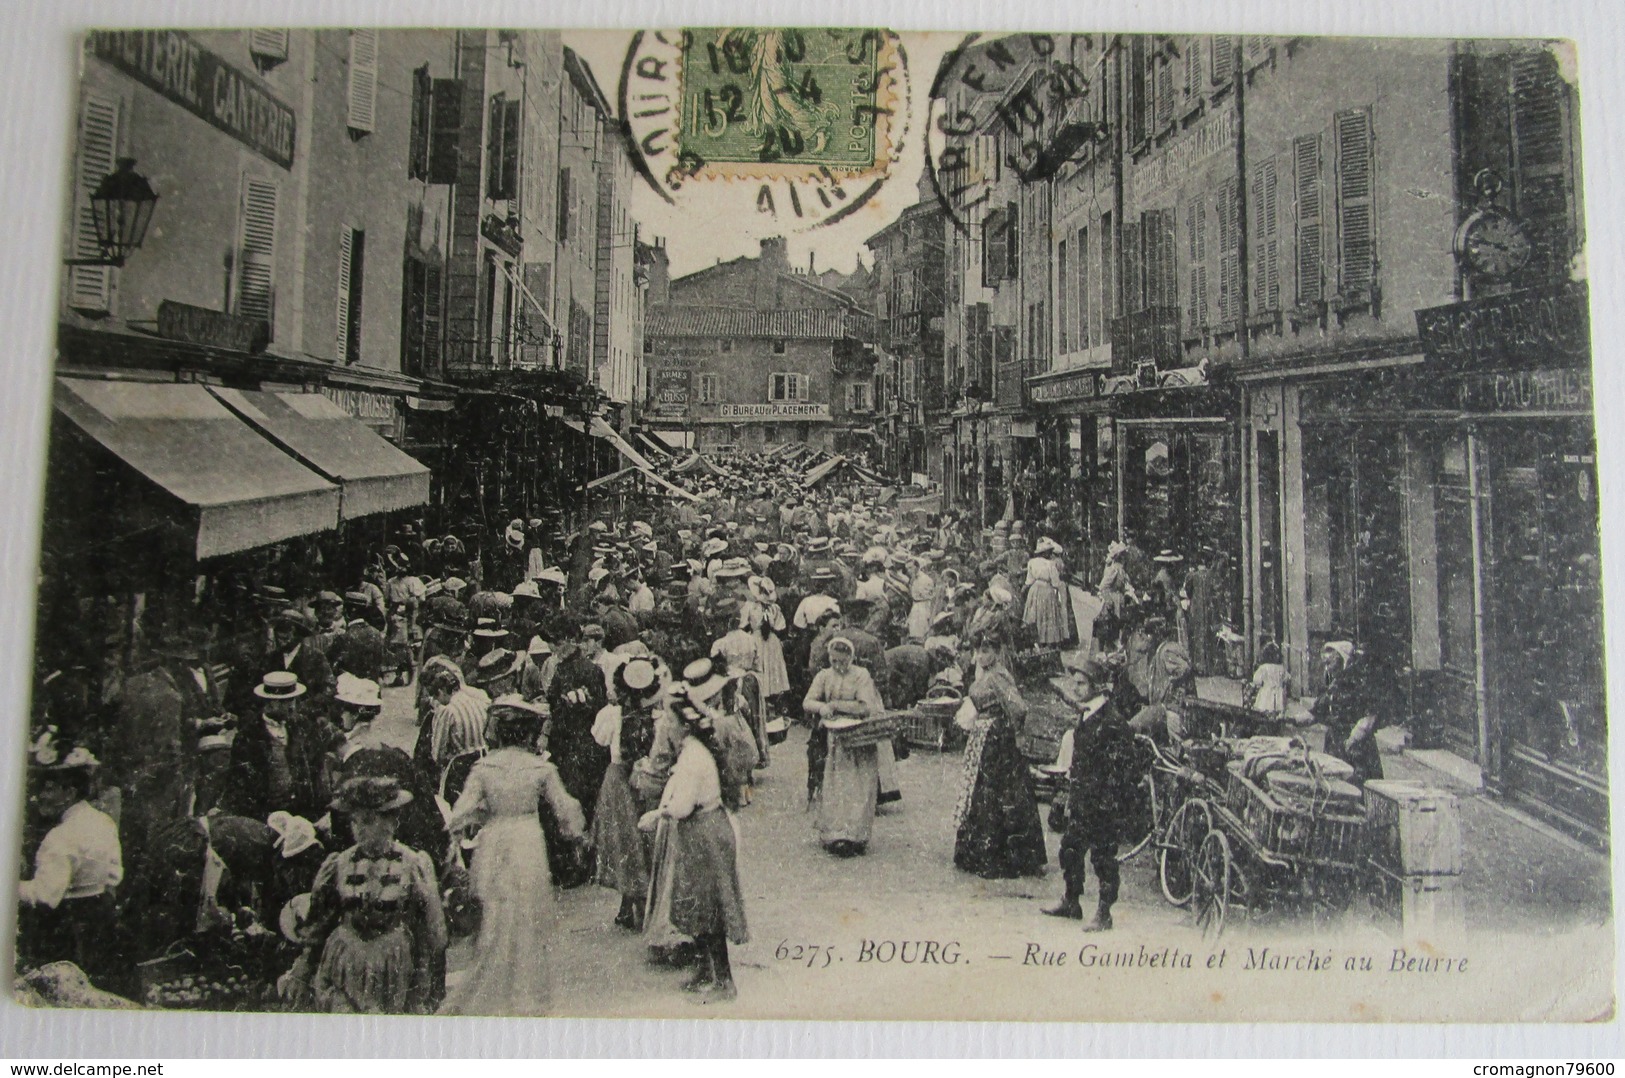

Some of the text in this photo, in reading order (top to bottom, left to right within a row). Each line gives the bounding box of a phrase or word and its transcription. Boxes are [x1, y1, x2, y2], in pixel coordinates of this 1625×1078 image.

[733, 404, 765, 416] BUREAU
[772, 404, 820, 416] PLACEMENT
[775, 938, 844, 969] 6275.
[856, 938, 970, 965] BOURG.
[1021, 942, 1067, 967] Rue
[1078, 944, 1193, 969] Gambetta
[1206, 948, 1226, 969] et
[1243, 947, 1332, 972] Marché
[1344, 956, 1373, 972] au
[1389, 948, 1469, 973] Beurre
